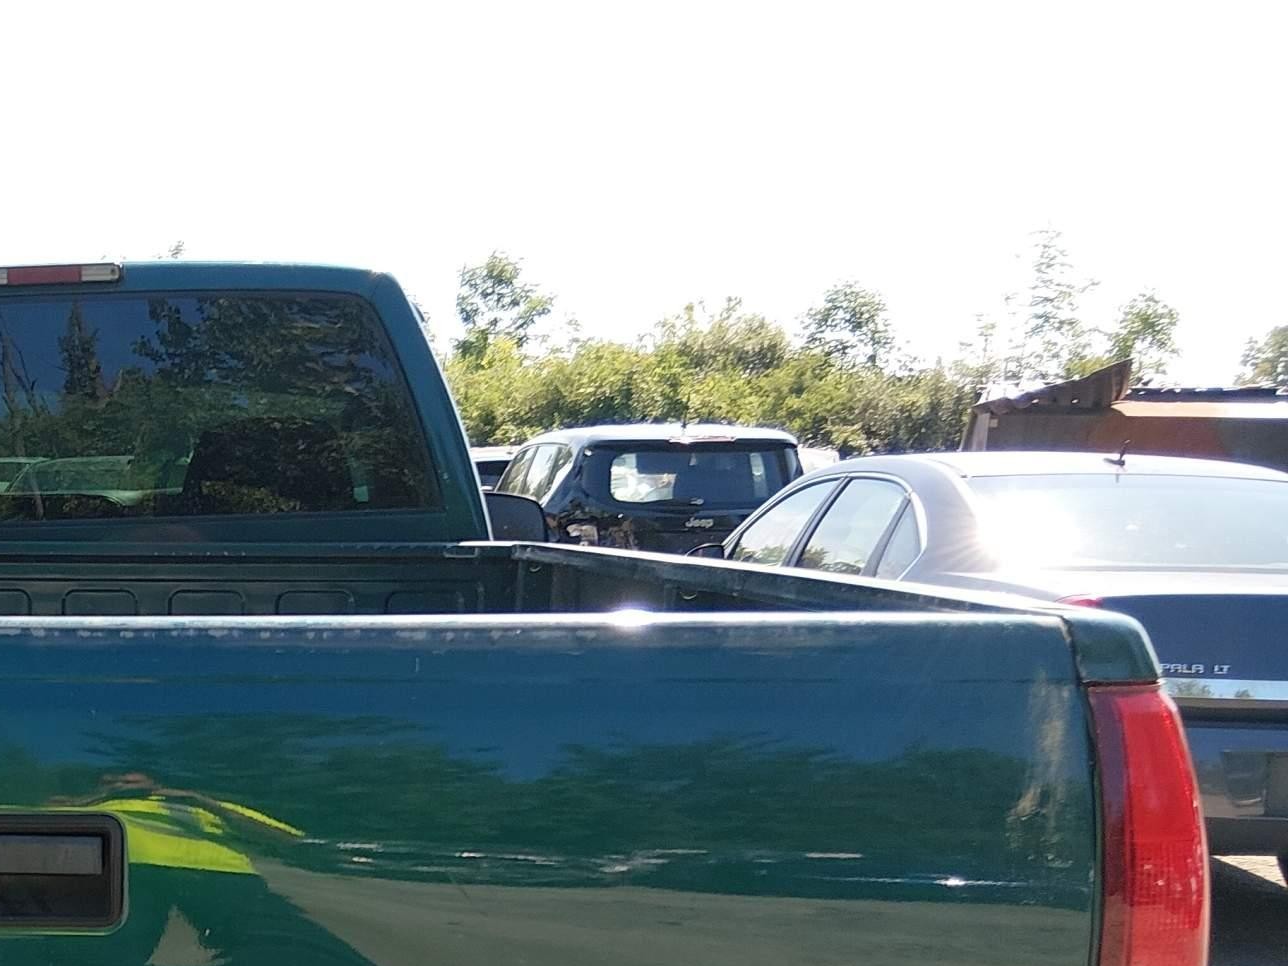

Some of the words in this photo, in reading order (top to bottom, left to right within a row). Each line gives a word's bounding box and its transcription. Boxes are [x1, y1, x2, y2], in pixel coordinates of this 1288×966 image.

[685, 517, 714, 528] Jeep
[1160, 663, 1205, 674] PALA
[1213, 664, 1231, 674] LT
